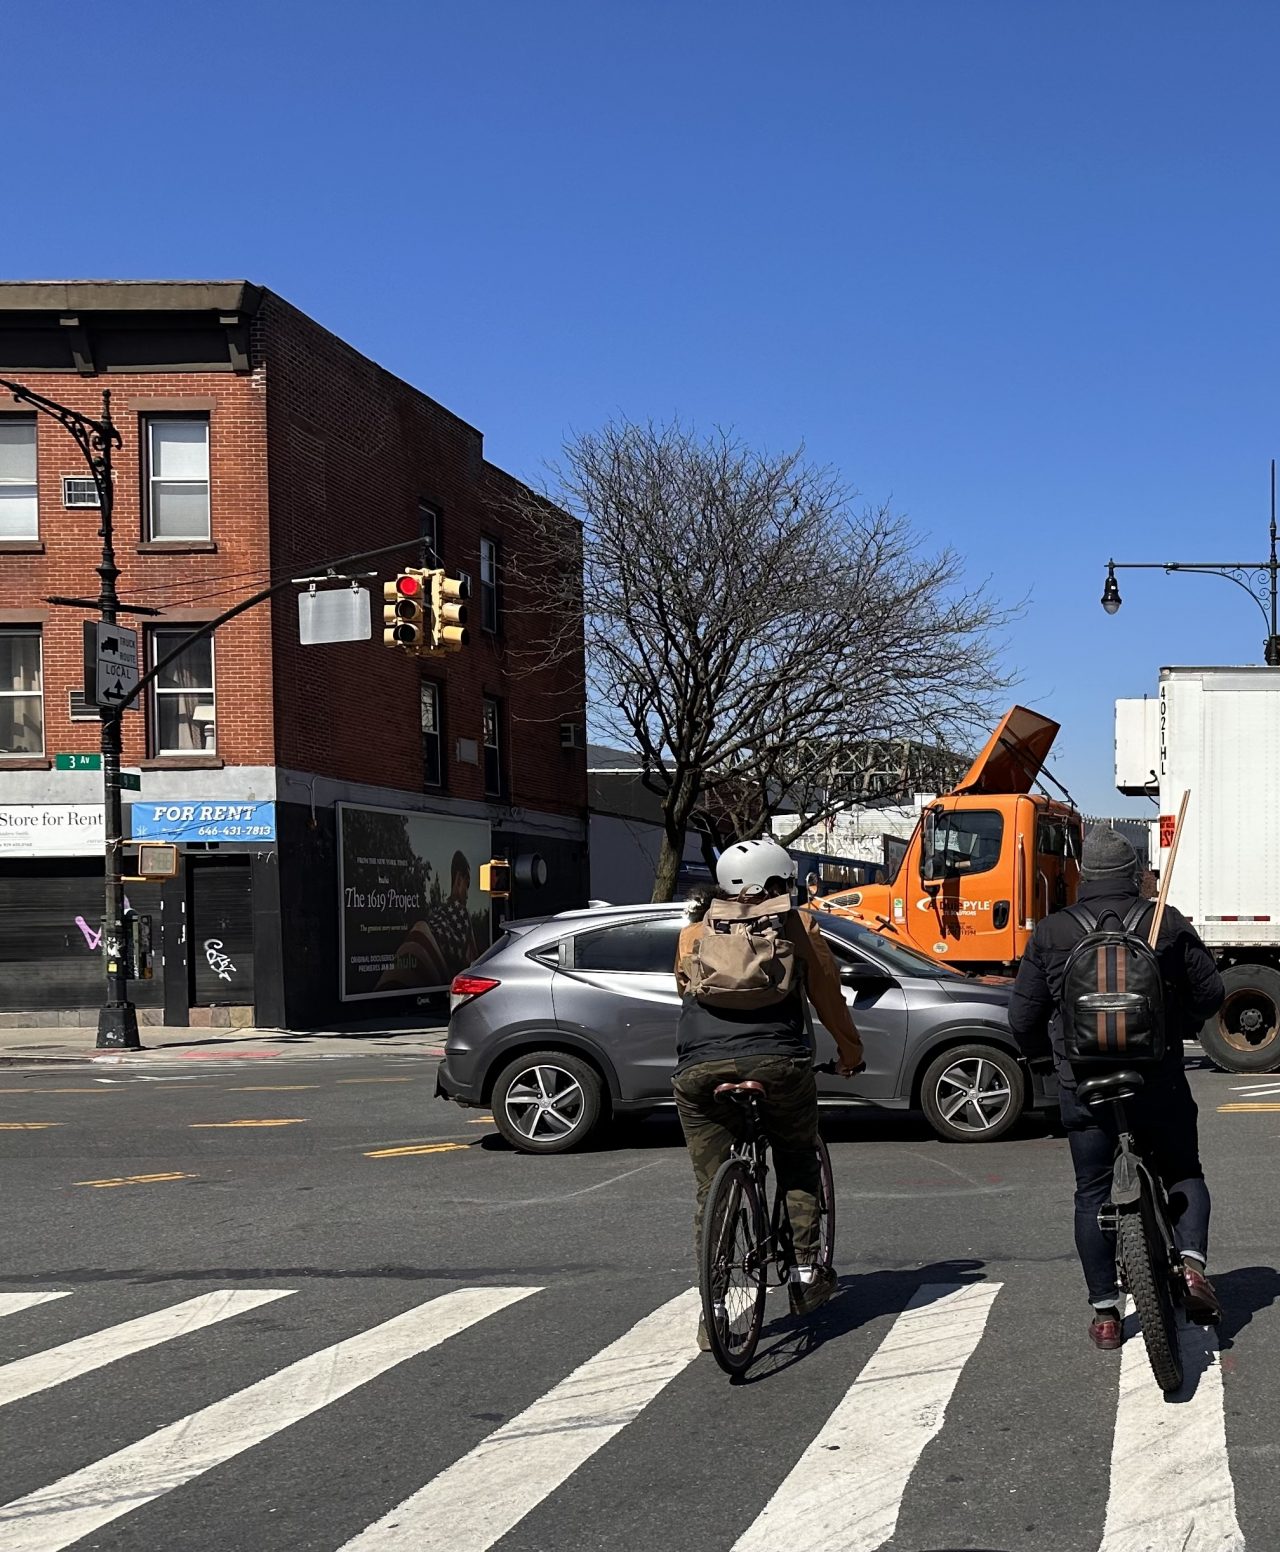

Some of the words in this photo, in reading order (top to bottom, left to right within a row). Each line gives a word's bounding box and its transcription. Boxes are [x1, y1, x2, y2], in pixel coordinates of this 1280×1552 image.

[105, 664, 132, 680] LOCAL
[69, 755, 76, 769] 3
[0, 812, 39, 827] Store
[42, 811, 64, 826] for
[67, 811, 104, 826] Rent
[153, 806, 195, 821] FOR
[199, 806, 257, 821] RENT
[198, 825, 271, 836] 646-431-7813
[344, 886, 365, 908] The
[367, 889, 386, 912] 1619
[388, 888, 420, 912] Project
